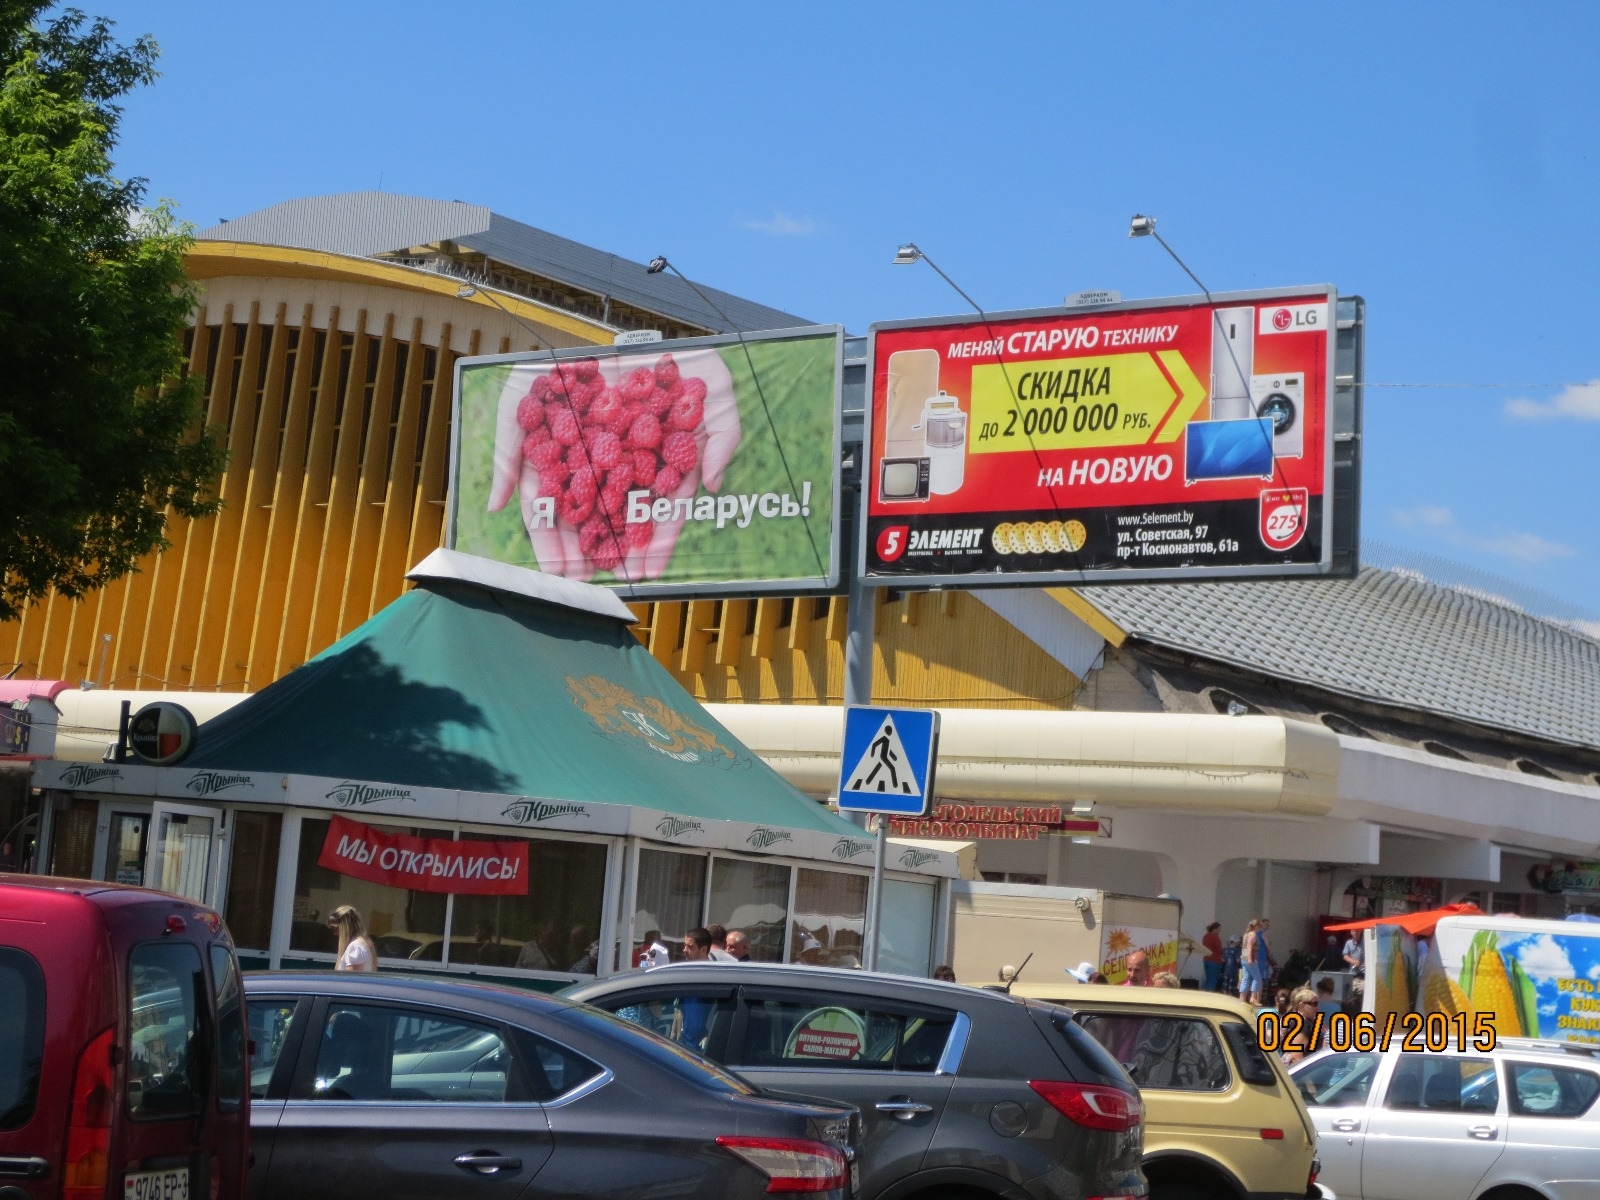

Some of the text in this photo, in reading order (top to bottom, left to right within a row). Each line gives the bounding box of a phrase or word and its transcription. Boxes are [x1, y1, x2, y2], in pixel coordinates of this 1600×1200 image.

[1295, 309, 1318, 326] LG
[947, 325, 1179, 358] МЕНЯЙ СТАРУЮ ТЕХНИКУ
[1017, 366, 1111, 403] СКИДКА
[979, 422, 999, 441] ДО
[1122, 412, 1151, 430] РУБ.
[1037, 454, 1173, 487] НА НОВУЮ
[529, 481, 812, 530] Я Беларусь!
[1117, 510, 1194, 526] www.5element.by
[1268, 514, 1298, 530] 275
[884, 531, 900, 555] 5
[908, 528, 984, 550] ЭЛЕМЕНТ
[1117, 525, 1208, 545] ул. Советская, 97
[1117, 539, 1239, 559] пр-т Космонавтов, 61а
[75, 764, 123, 787] Крыніца
[200, 771, 254, 794] Крыніца
[348, 783, 416, 806] Крыніца
[520, 800, 590, 824] Крыніца
[336, 834, 520, 880] МЫ ОТКРЫЛИСЬ!
[1103, 942, 1166, 976] СЕЛЧКА
[1557, 978, 1594, 993] ЕСТЬ
[803, 1044, 850, 1056] САЛОН-МАГАЗИН
[136, 1176, 160, 1200] 9746
